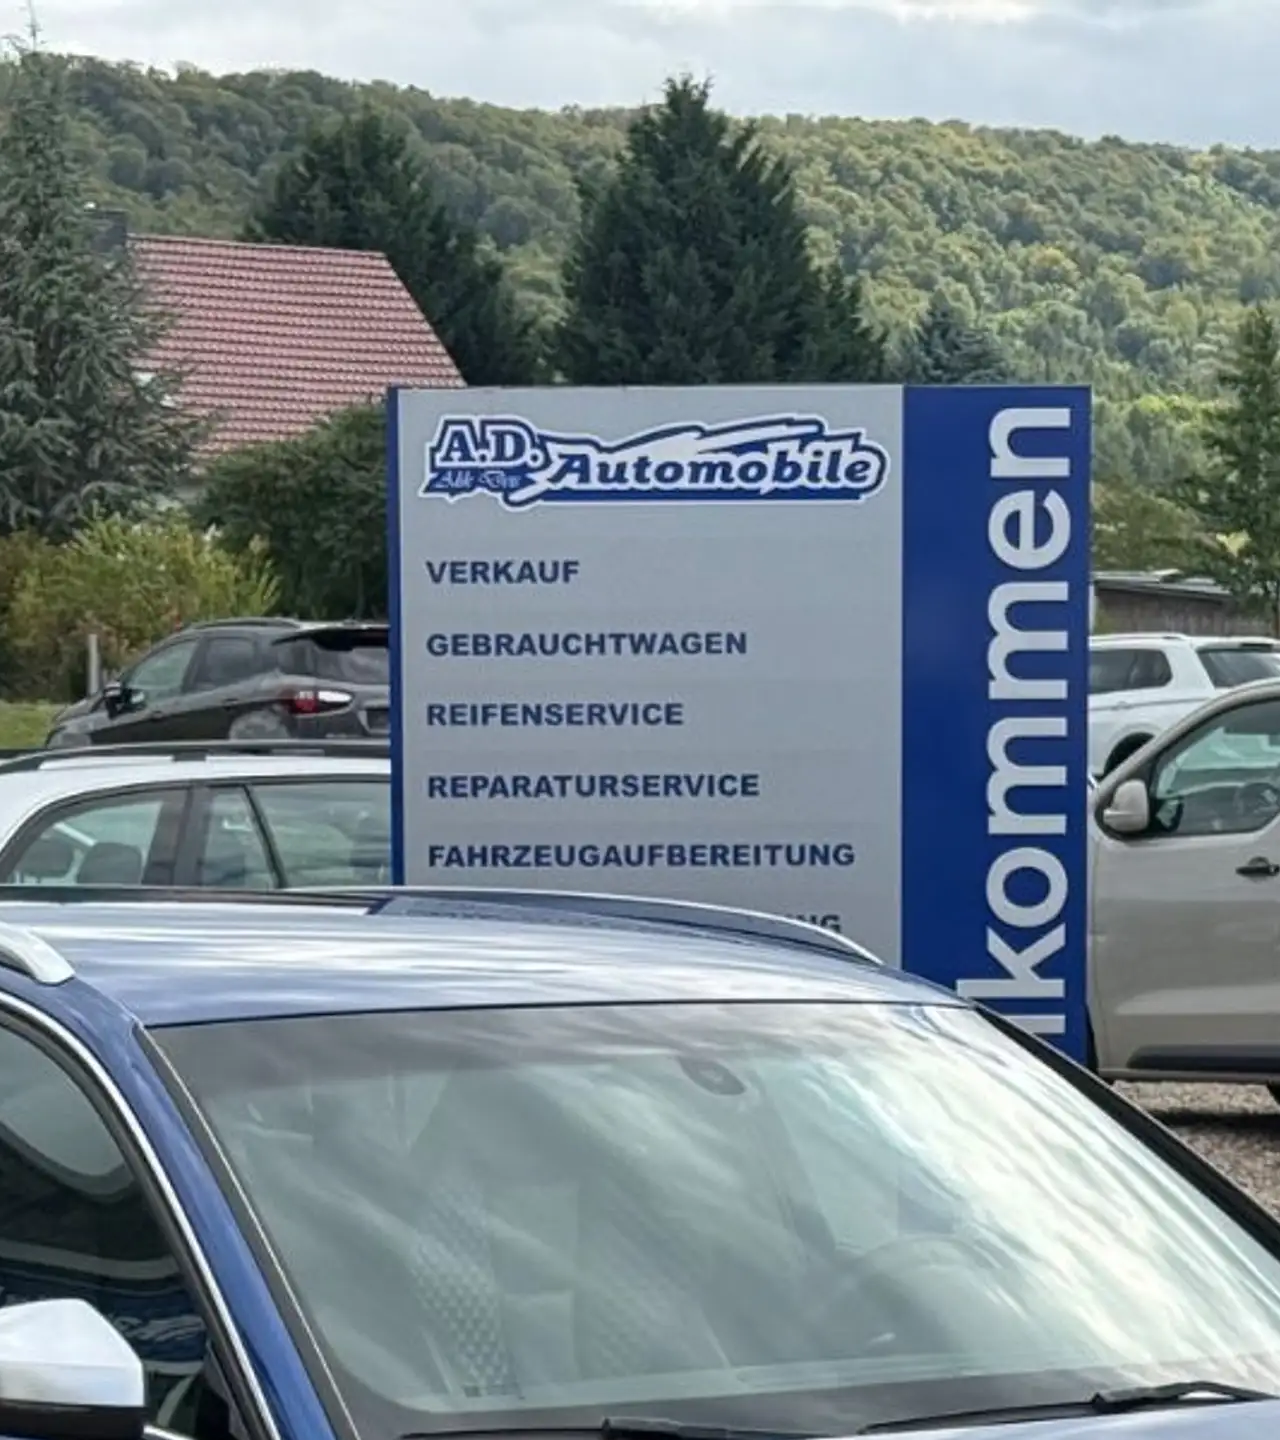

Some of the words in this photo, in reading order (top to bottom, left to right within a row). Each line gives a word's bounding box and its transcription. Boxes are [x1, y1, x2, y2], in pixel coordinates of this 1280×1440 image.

[437, 429, 542, 464] A.D.
[547, 438, 871, 487] Automobile
[426, 560, 580, 584] VERKAUF
[426, 632, 748, 657] GEBRAUCHTWAGEN
[427, 702, 684, 726] REIFENSERVICE
[428, 774, 760, 798] REPARATURSERVICE
[428, 844, 856, 867] FAHRZEUGAUFBEREITUNG
